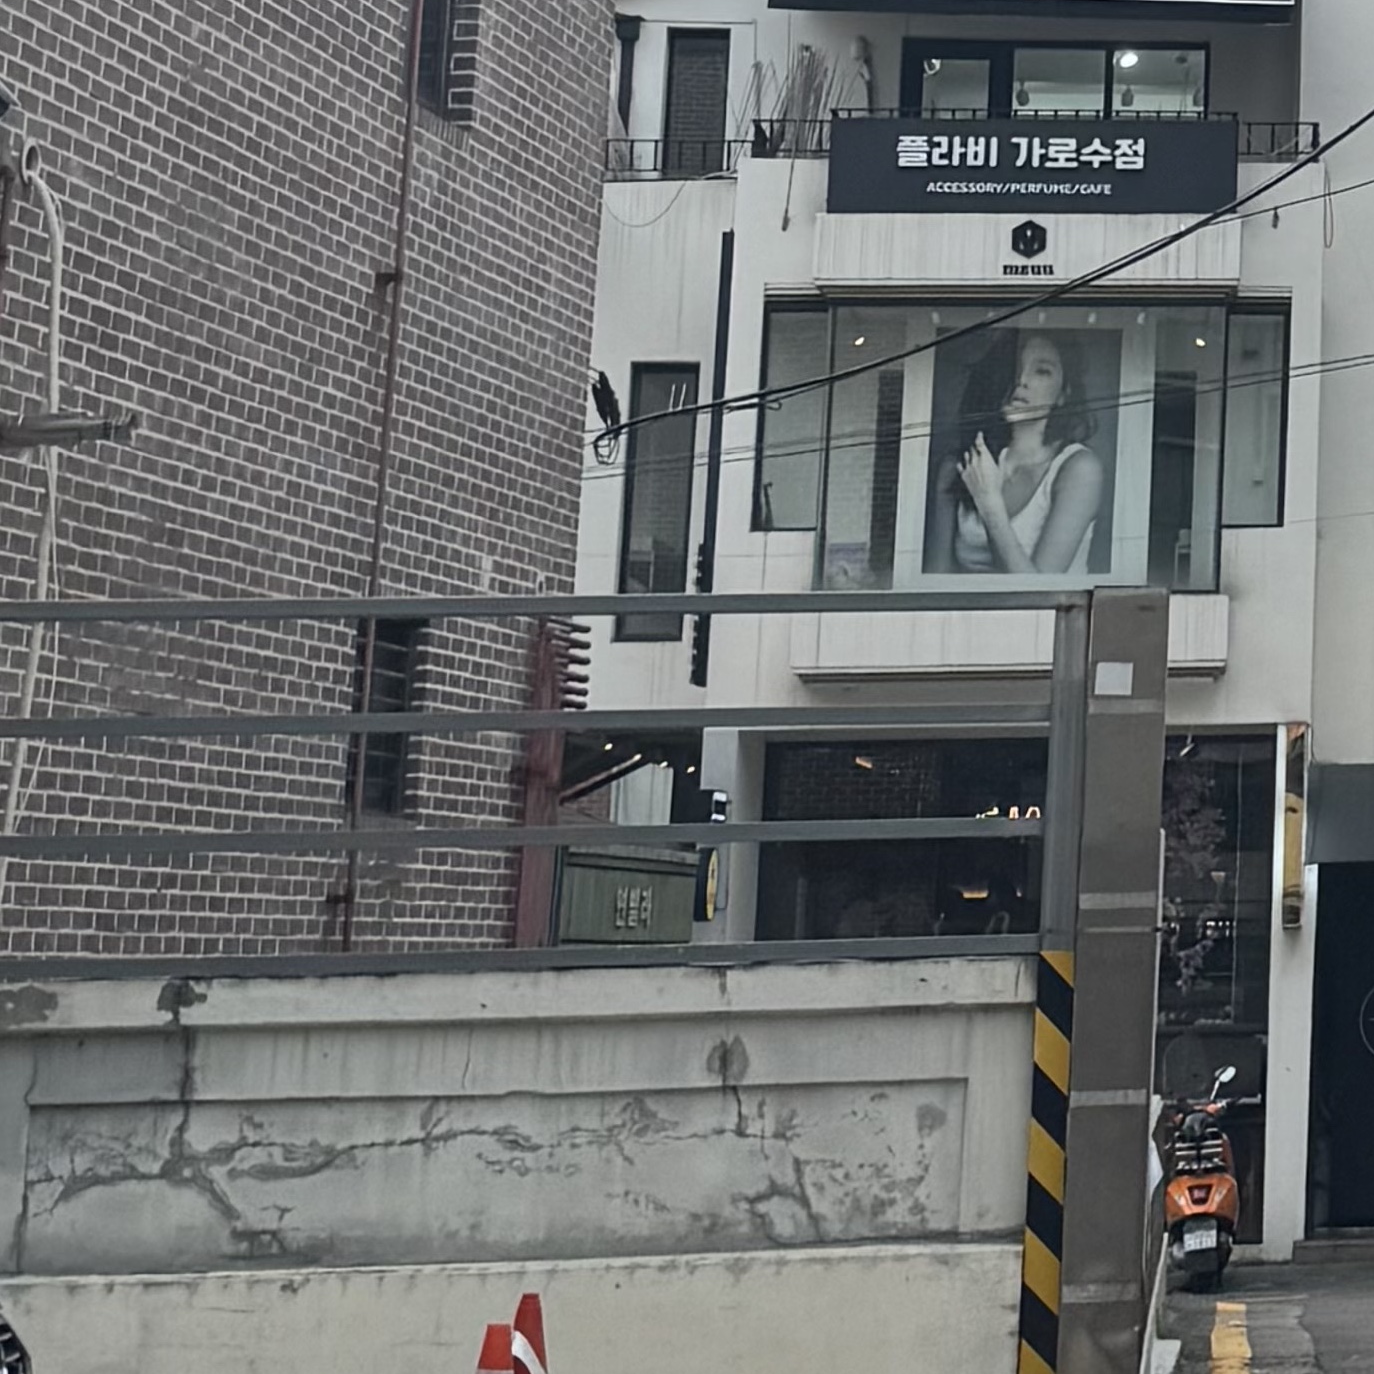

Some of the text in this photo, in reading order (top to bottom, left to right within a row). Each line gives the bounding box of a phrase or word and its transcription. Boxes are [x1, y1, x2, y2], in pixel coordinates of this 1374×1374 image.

[896, 135, 1146, 170] 플라비 가로수점
[926, 181, 1112, 195] ACCESSORY/PERFUME/CAFE
